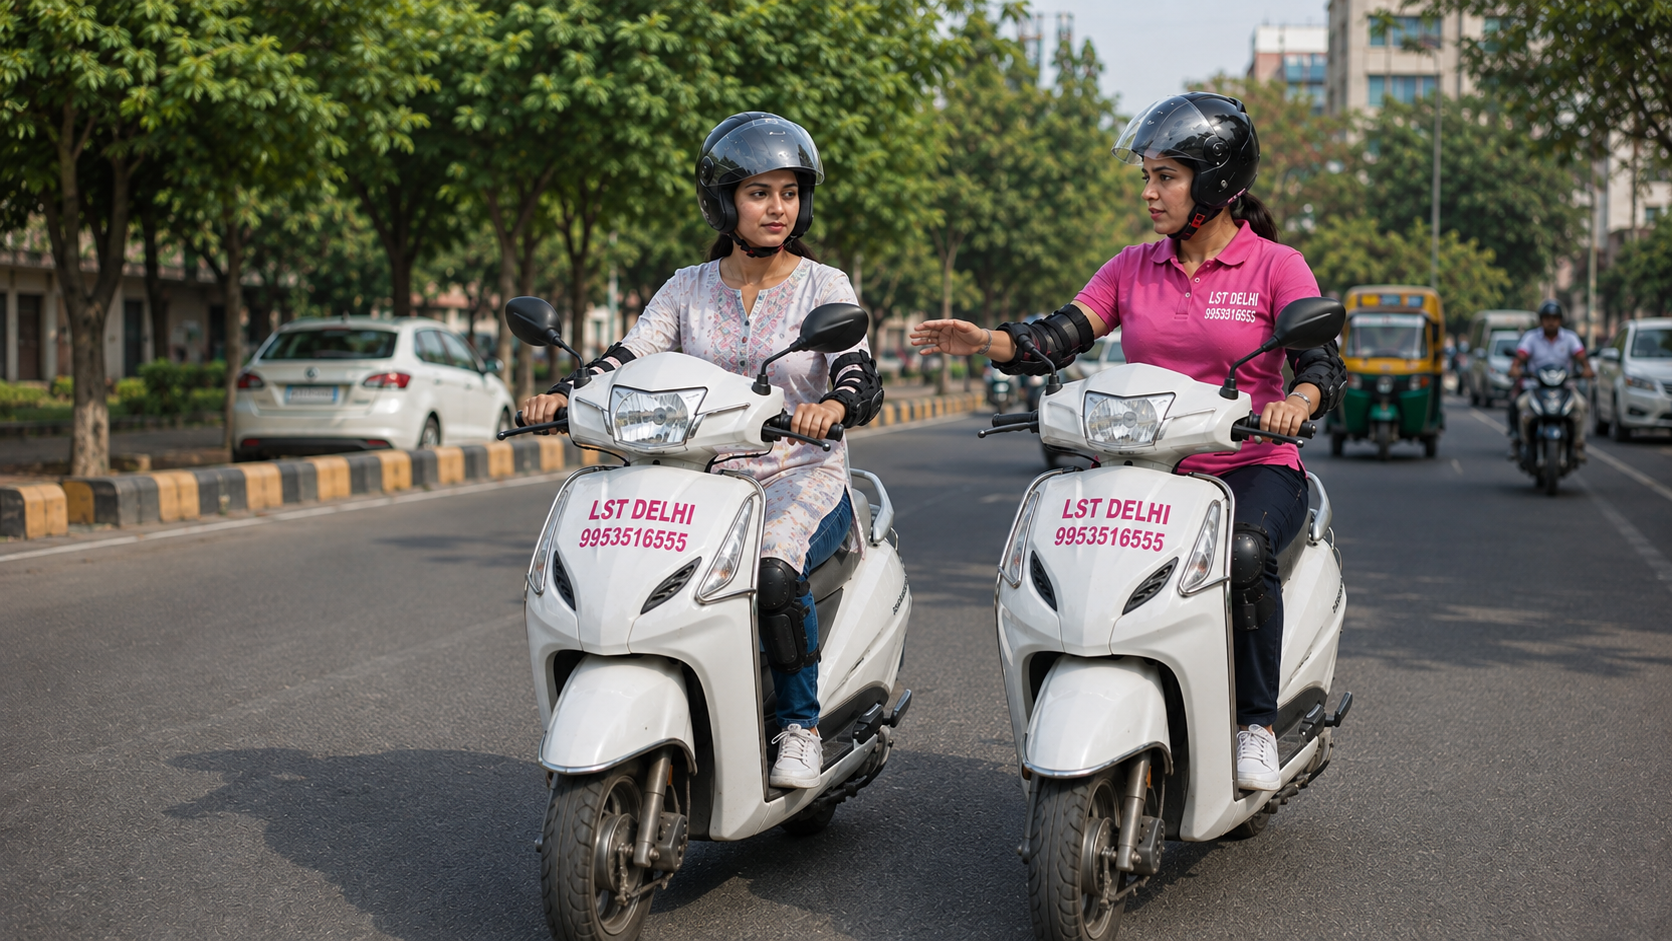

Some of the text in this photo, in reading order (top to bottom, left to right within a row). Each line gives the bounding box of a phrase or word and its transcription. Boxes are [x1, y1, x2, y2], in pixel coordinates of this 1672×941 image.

[1209, 291, 1259, 306] LST DELHI
[589, 499, 695, 525] LST DELHI
[1062, 498, 1171, 525] LST DELHI
[579, 527, 688, 552] 9953516555
[1055, 526, 1165, 552] 9953516555
